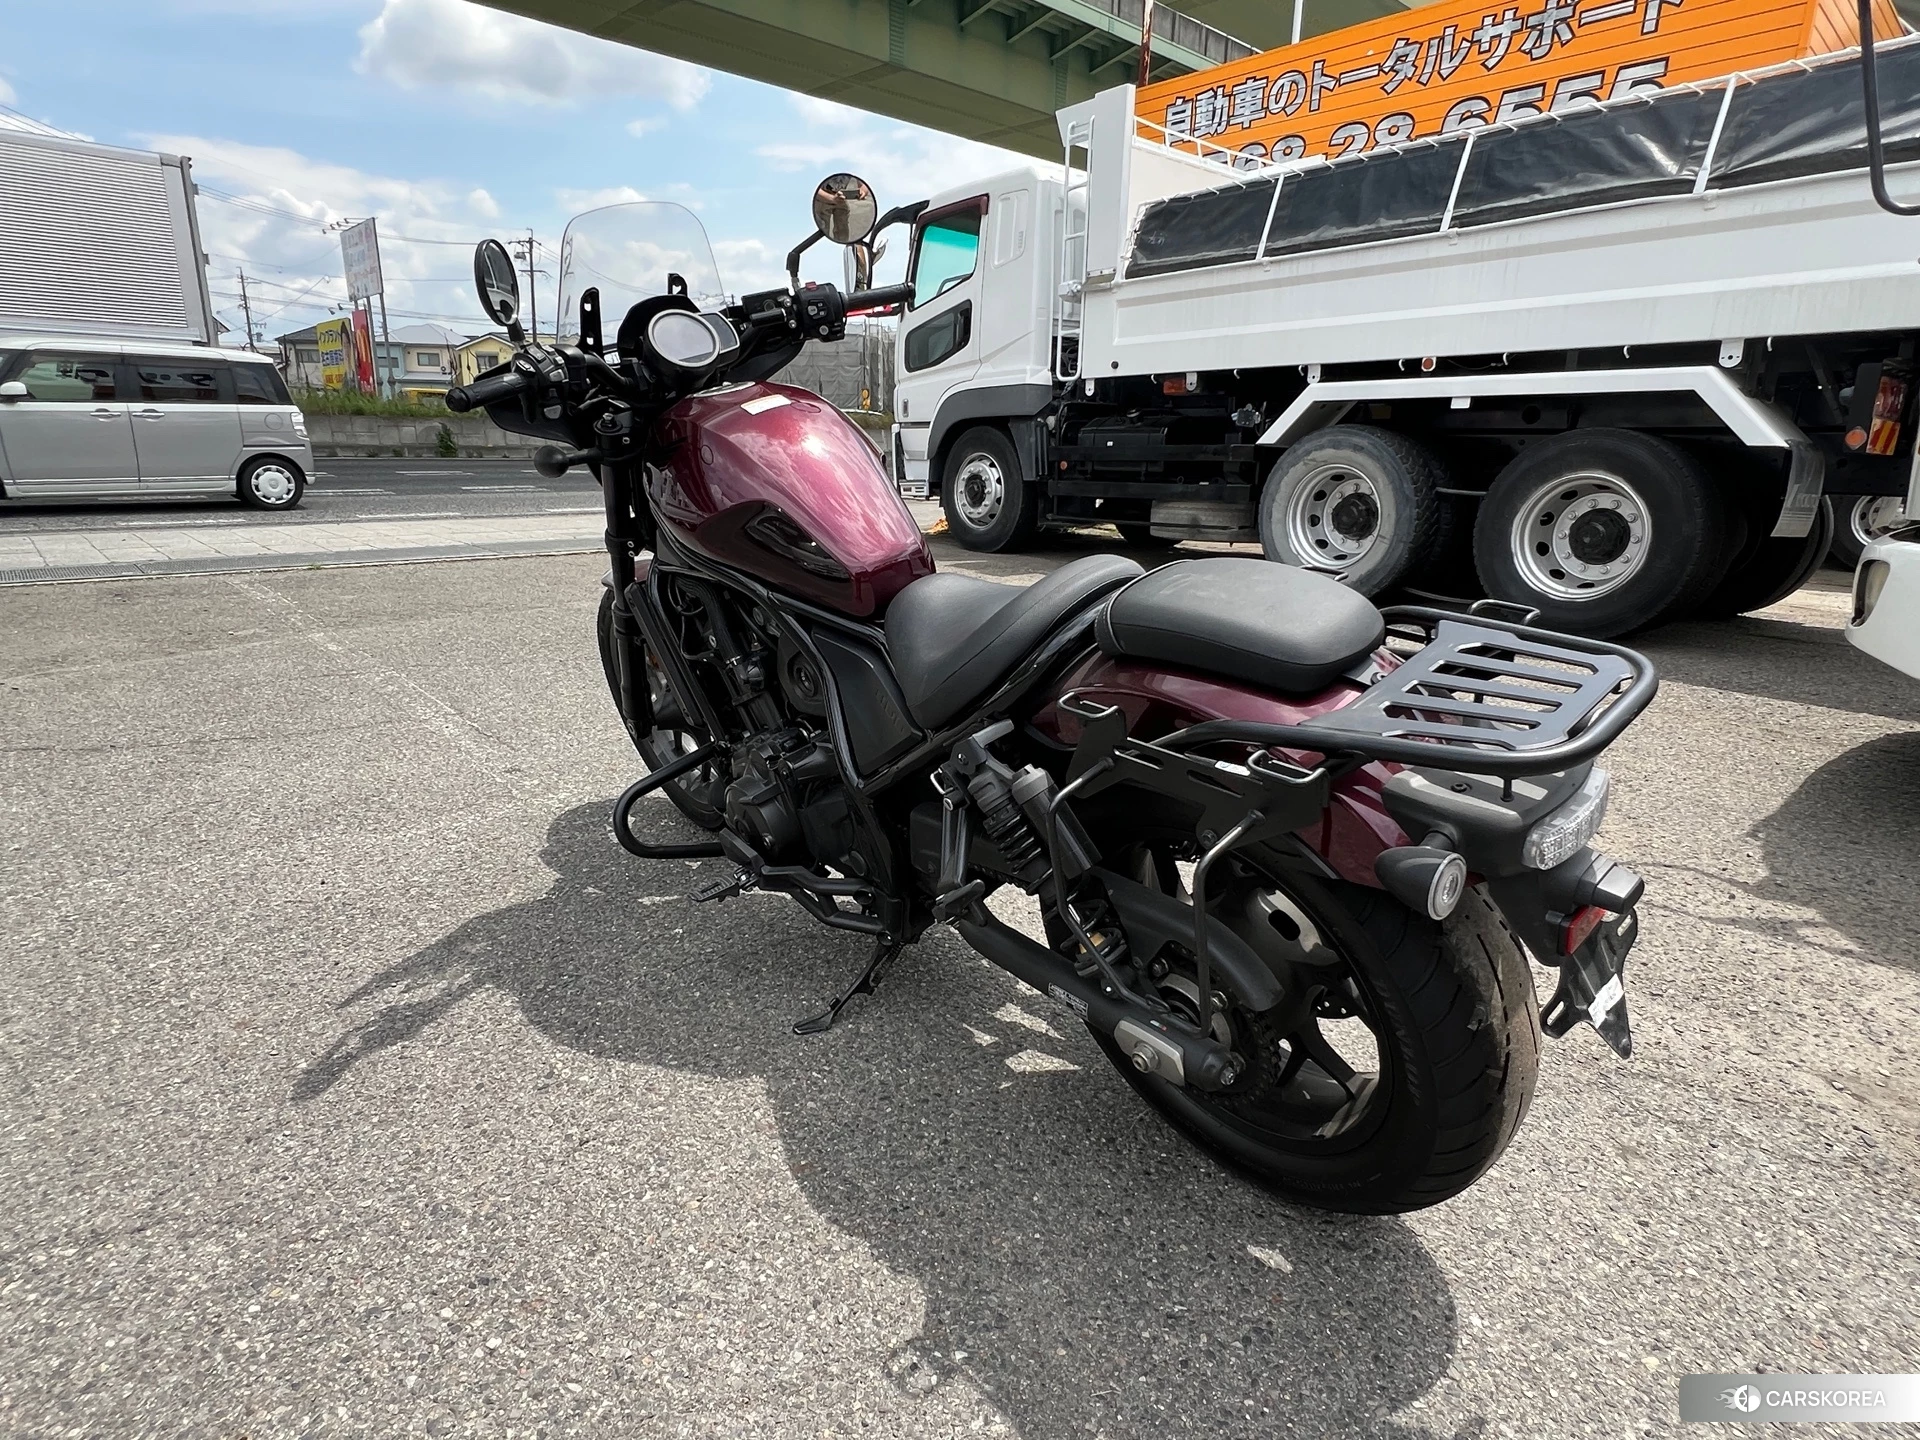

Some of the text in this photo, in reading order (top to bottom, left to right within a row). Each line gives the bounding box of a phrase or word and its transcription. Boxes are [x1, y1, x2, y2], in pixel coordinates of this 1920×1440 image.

[1164, 0, 1685, 146] 自動車のトータルサポート
